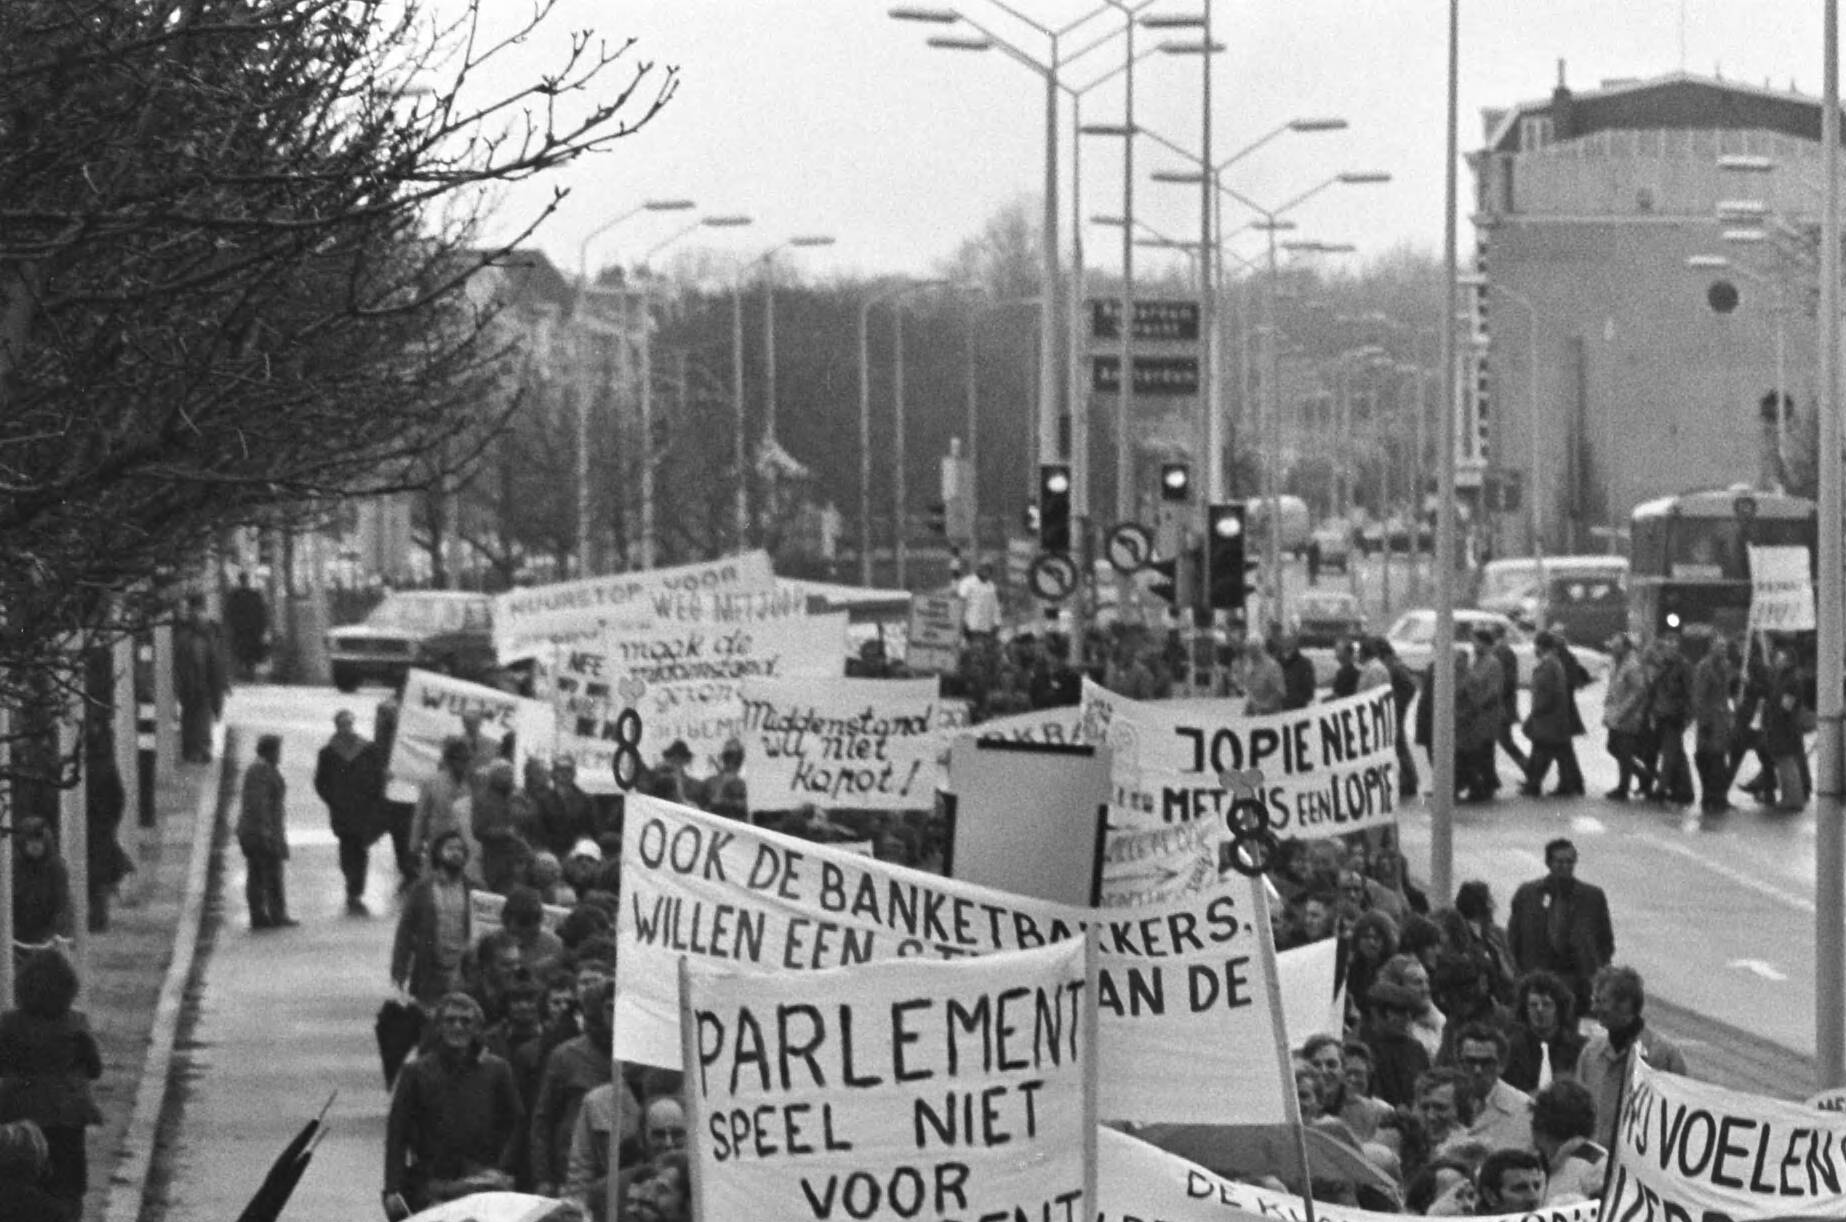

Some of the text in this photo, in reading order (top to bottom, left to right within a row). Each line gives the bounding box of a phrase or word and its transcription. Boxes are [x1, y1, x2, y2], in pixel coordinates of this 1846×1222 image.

[1175, 719, 1313, 776] JOPIE
[639, 817, 727, 883] OOK
[748, 841, 803, 901] DE
[632, 892, 765, 961] WILLEN
[783, 917, 875, 970] EEN
[1099, 966, 1167, 1017] AN
[1188, 956, 1252, 1013] DE
[695, 980, 1086, 1097] PARLEMENT
[709, 1080, 1044, 1162] SPEEL NIET
[1660, 1097, 1841, 1196] VOELEN
[801, 1162, 970, 1220] VOOR
